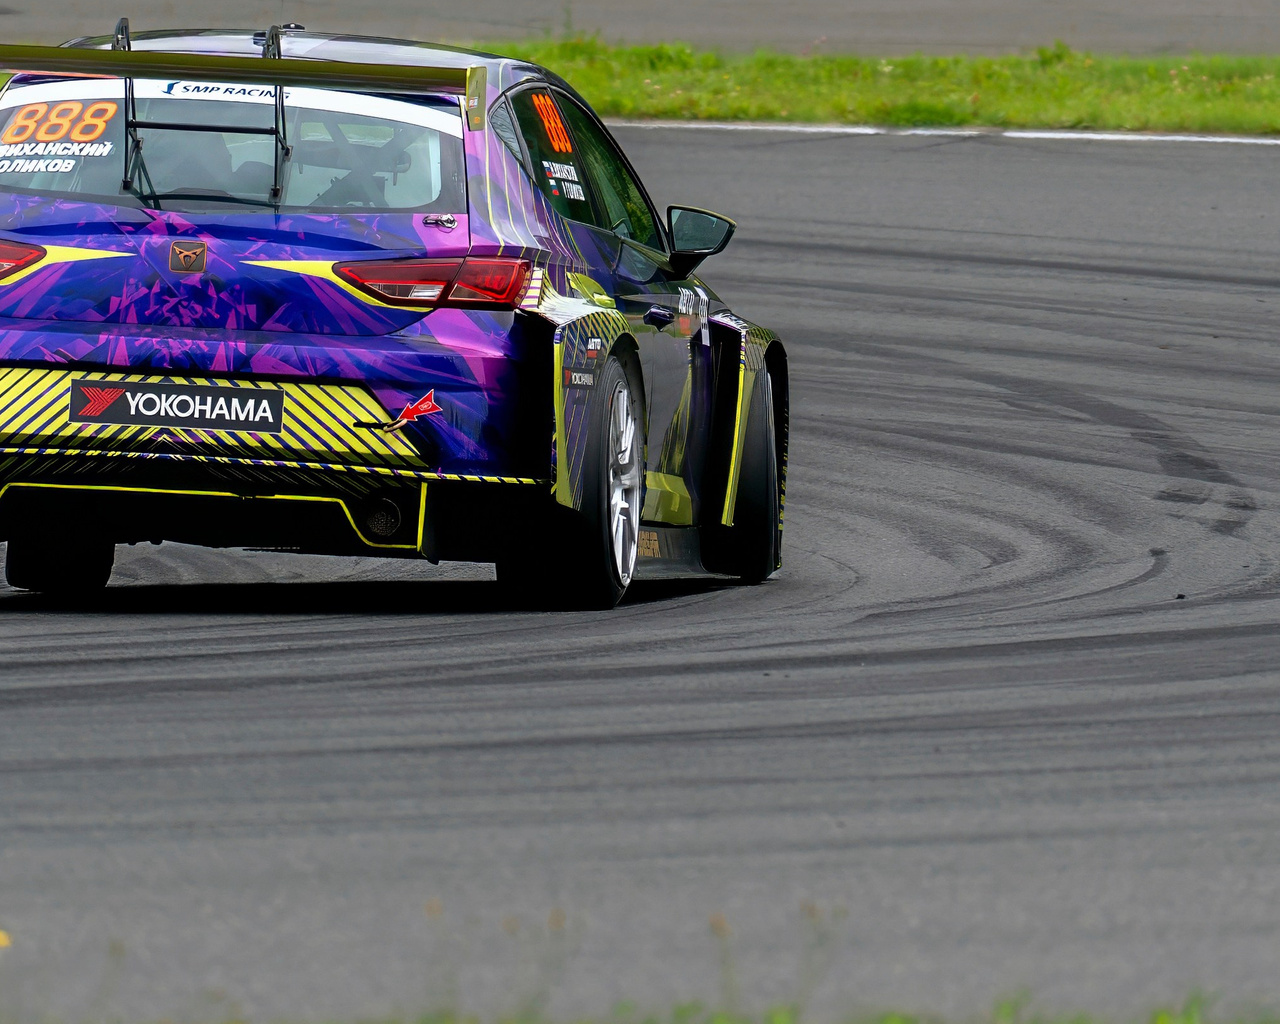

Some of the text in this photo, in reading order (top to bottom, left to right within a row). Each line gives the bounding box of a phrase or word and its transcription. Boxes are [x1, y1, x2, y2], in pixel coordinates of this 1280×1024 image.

[181, 84, 221, 94] SMP
[1, 101, 118, 144] 888
[531, 93, 573, 154] 888
[125, 391, 274, 423] YOKOHAMA
